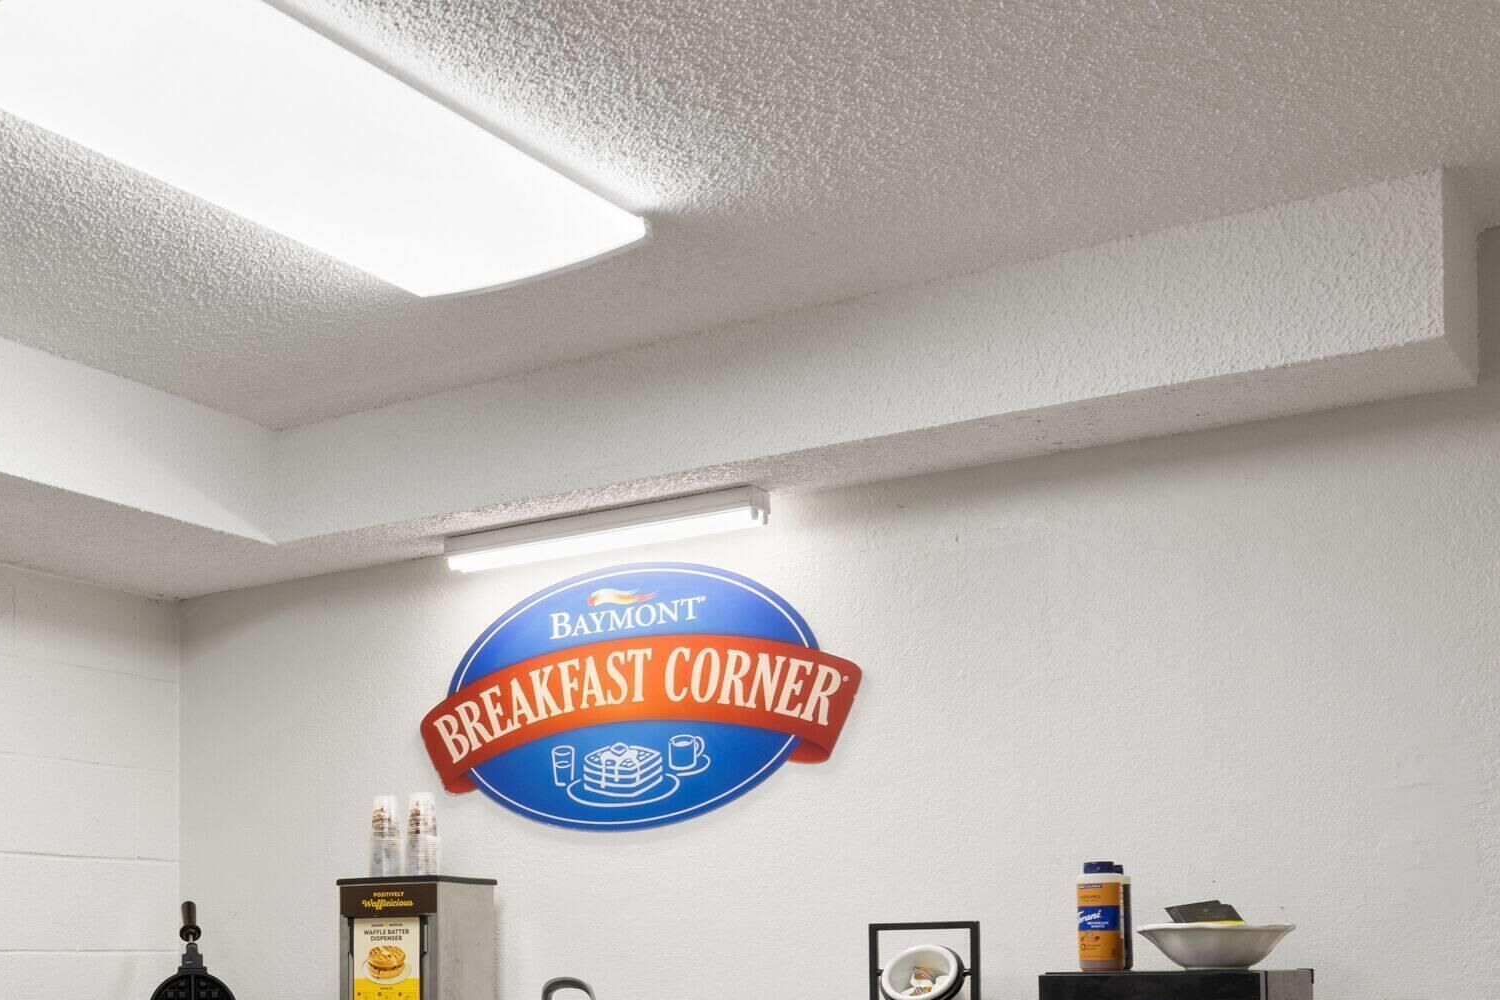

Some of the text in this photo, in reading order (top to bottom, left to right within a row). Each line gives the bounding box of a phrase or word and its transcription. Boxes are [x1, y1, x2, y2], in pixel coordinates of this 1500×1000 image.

[549, 596, 701, 640] BAYMONT
[433, 646, 845, 764] BREAKFAST CORNER
